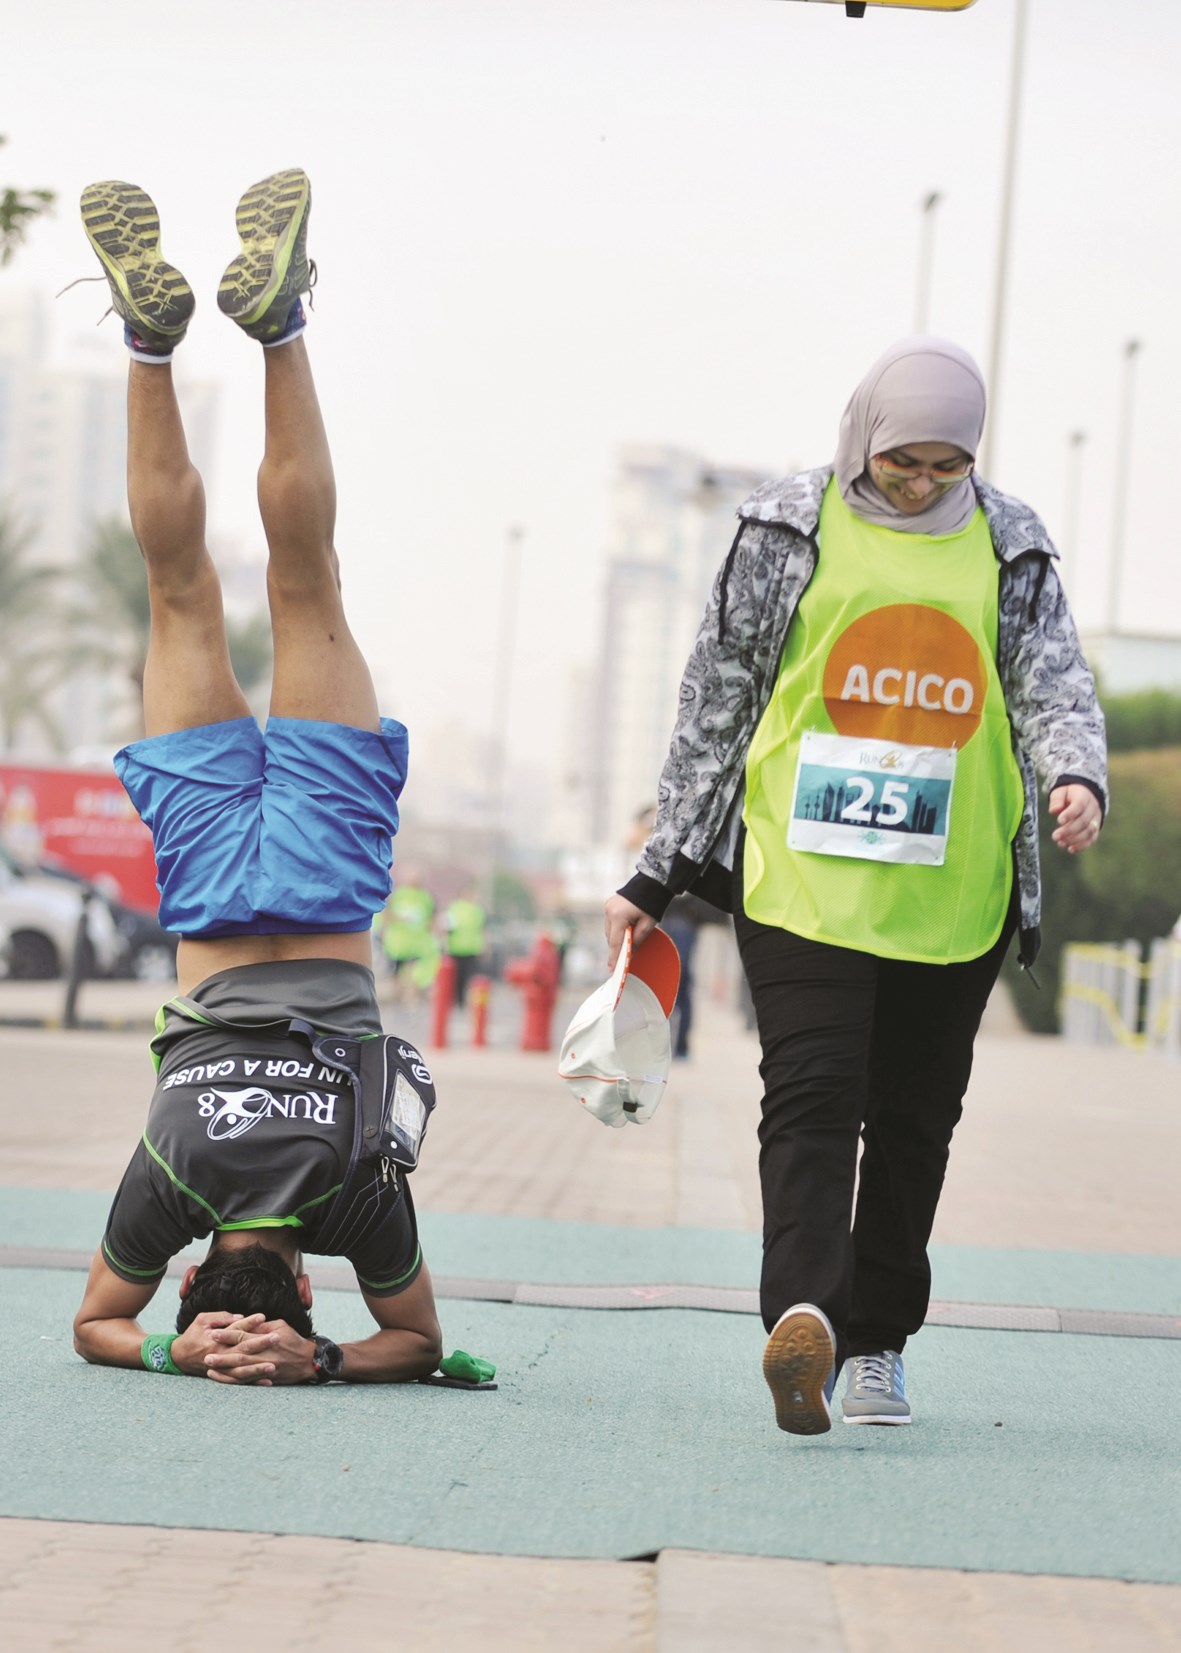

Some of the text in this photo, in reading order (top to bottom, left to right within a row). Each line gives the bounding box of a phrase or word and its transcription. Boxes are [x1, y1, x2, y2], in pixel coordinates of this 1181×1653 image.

[840, 664, 974, 715] ACICO
[840, 776, 910, 826] 25
[163, 1059, 353, 1091] UN FOR A CAUSE
